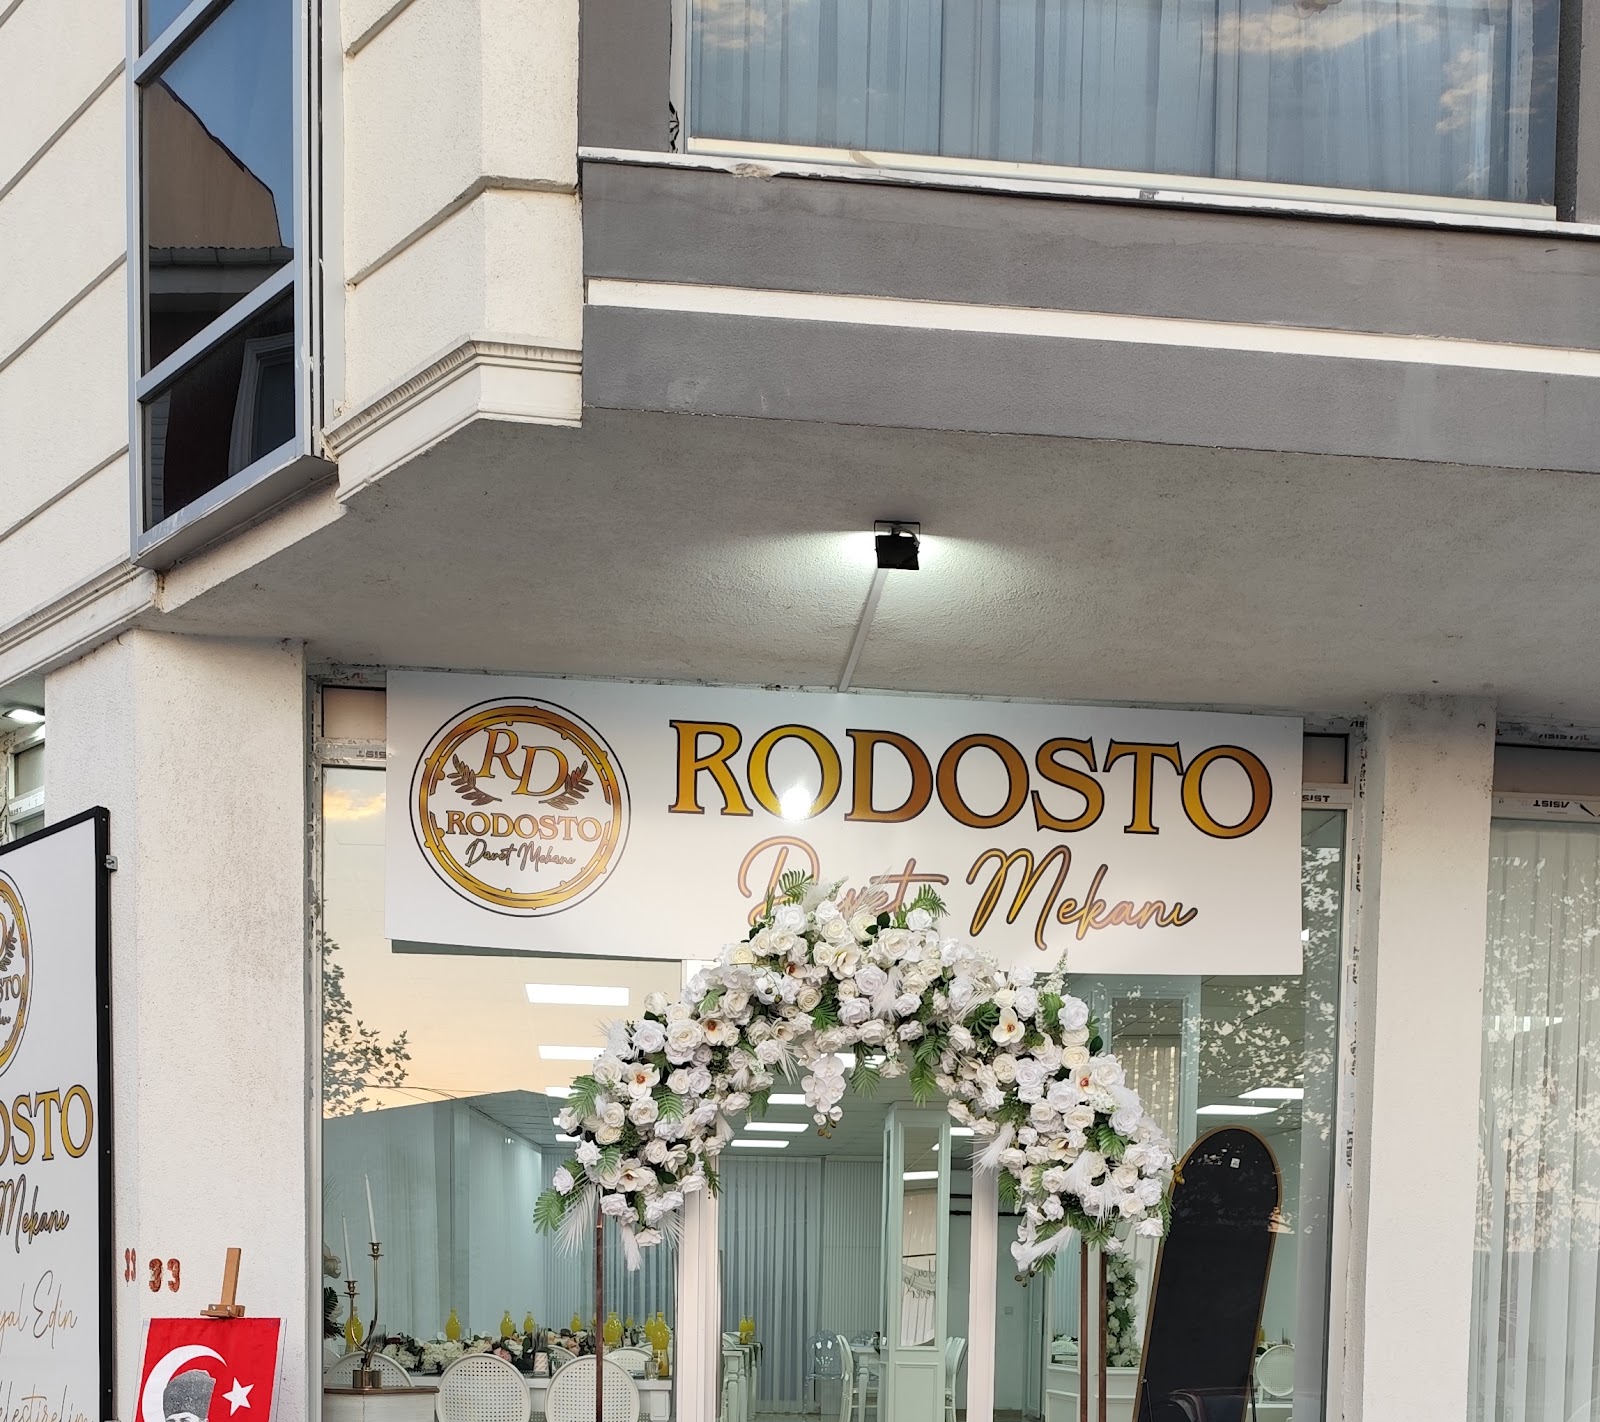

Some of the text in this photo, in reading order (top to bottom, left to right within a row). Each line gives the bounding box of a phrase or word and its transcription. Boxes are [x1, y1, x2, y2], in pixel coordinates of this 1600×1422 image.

[475, 728, 569, 796] RD
[667, 719, 1273, 840] RODOSTO
[1302, 794, 1330, 803] SIST
[446, 810, 602, 842] RODOSTO
[465, 838, 517, 868] Davet
[33, 1269, 78, 1350] Edin
